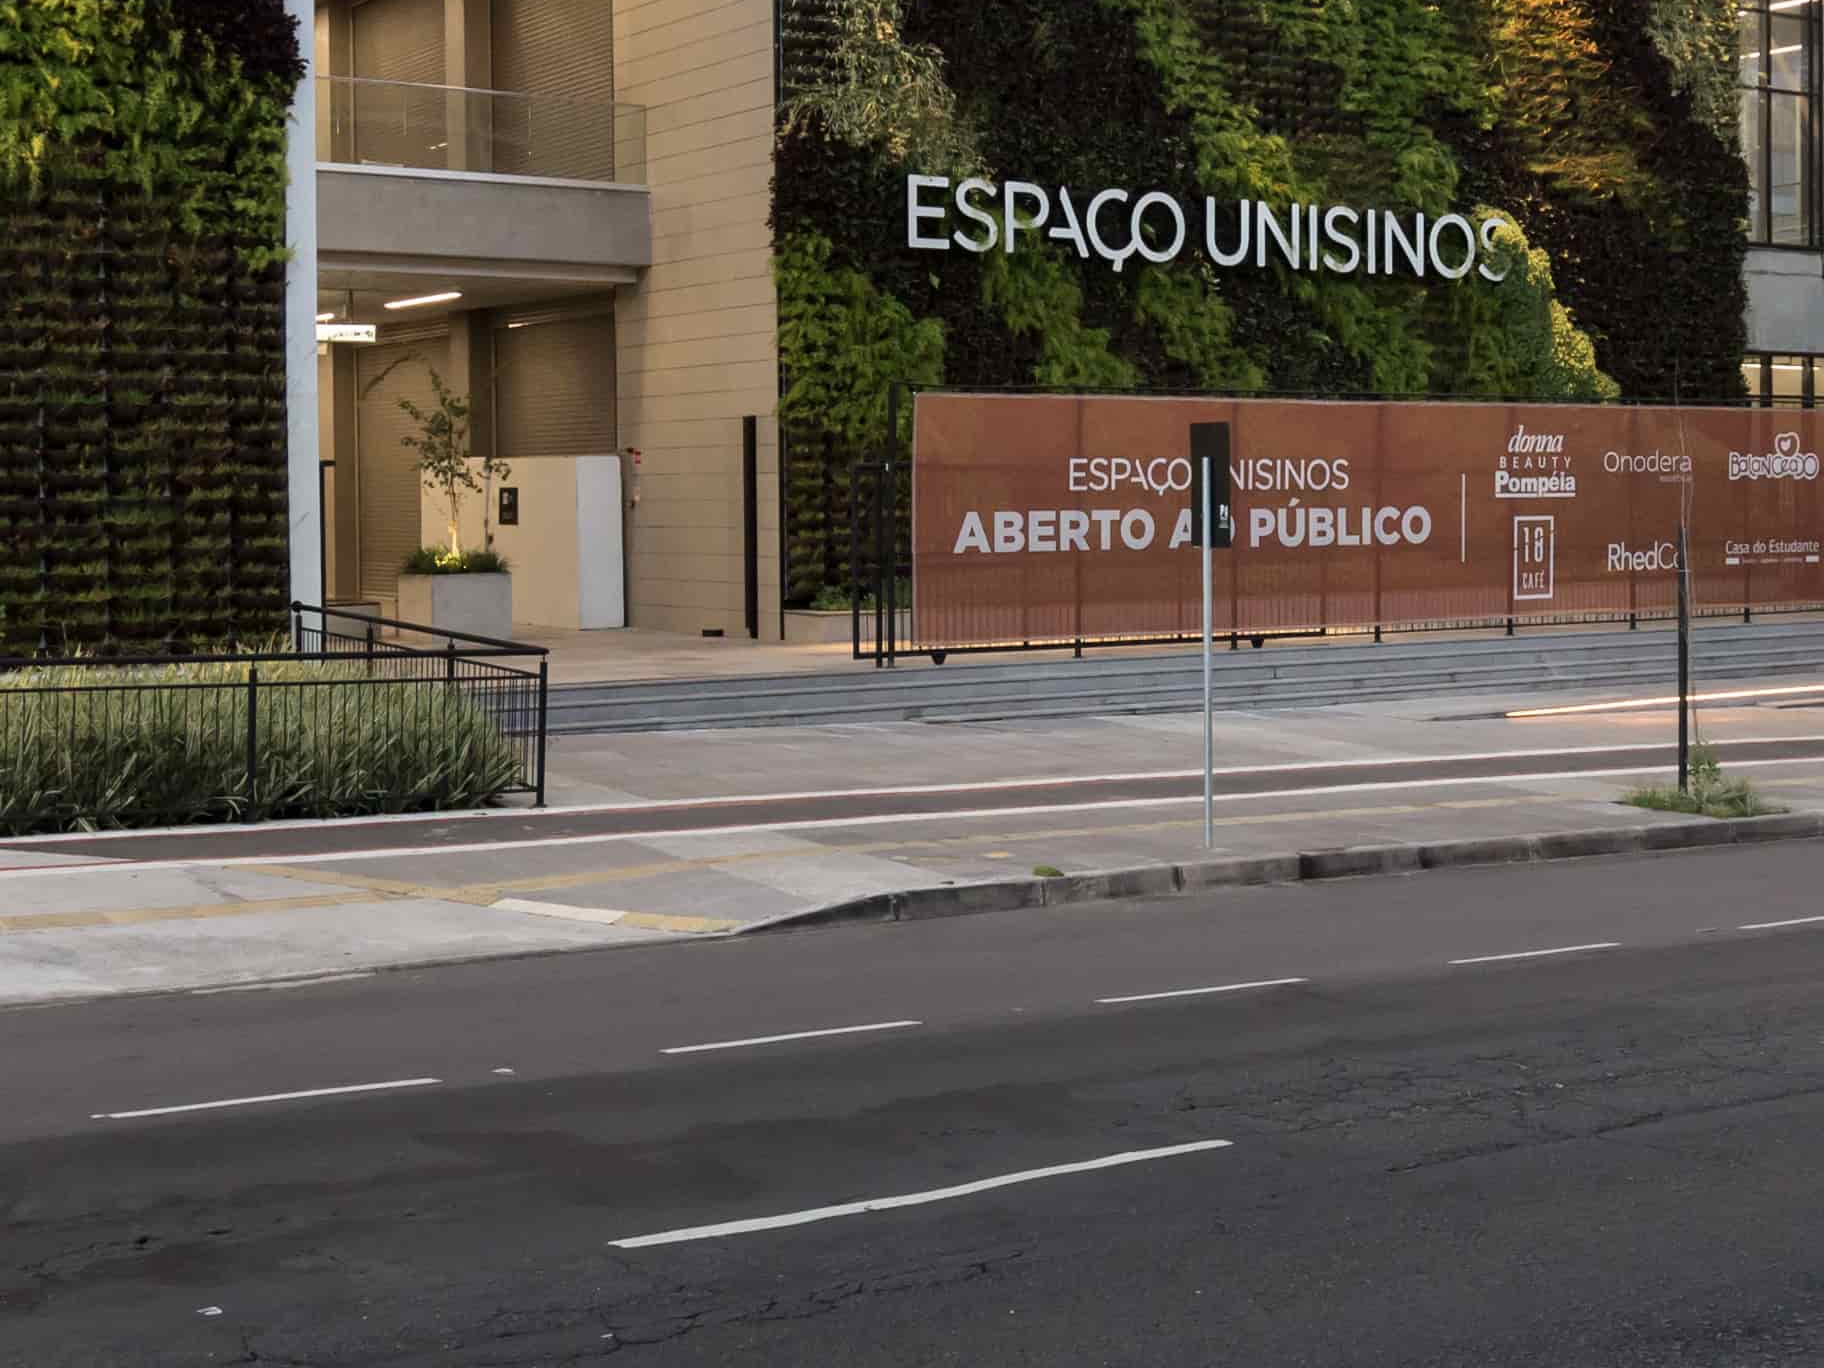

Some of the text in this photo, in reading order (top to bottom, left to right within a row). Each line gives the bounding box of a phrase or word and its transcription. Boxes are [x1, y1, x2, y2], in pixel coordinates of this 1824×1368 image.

[906, 173, 1510, 283] ESPAÇO UNISINOS
[1507, 424, 1565, 454] donna
[1499, 455, 1572, 470] BEAUTY
[1603, 448, 1693, 473] Onodera
[1068, 457, 1350, 496] ESPAÇO NISINOS
[952, 507, 1156, 554] ABERTO
[1249, 498, 1432, 548] PÚBLICO
[1522, 527, 1545, 563] 18
[1725, 538, 1821, 554] Casa do Estudante
[1521, 570, 1545, 590] CAFÉ
